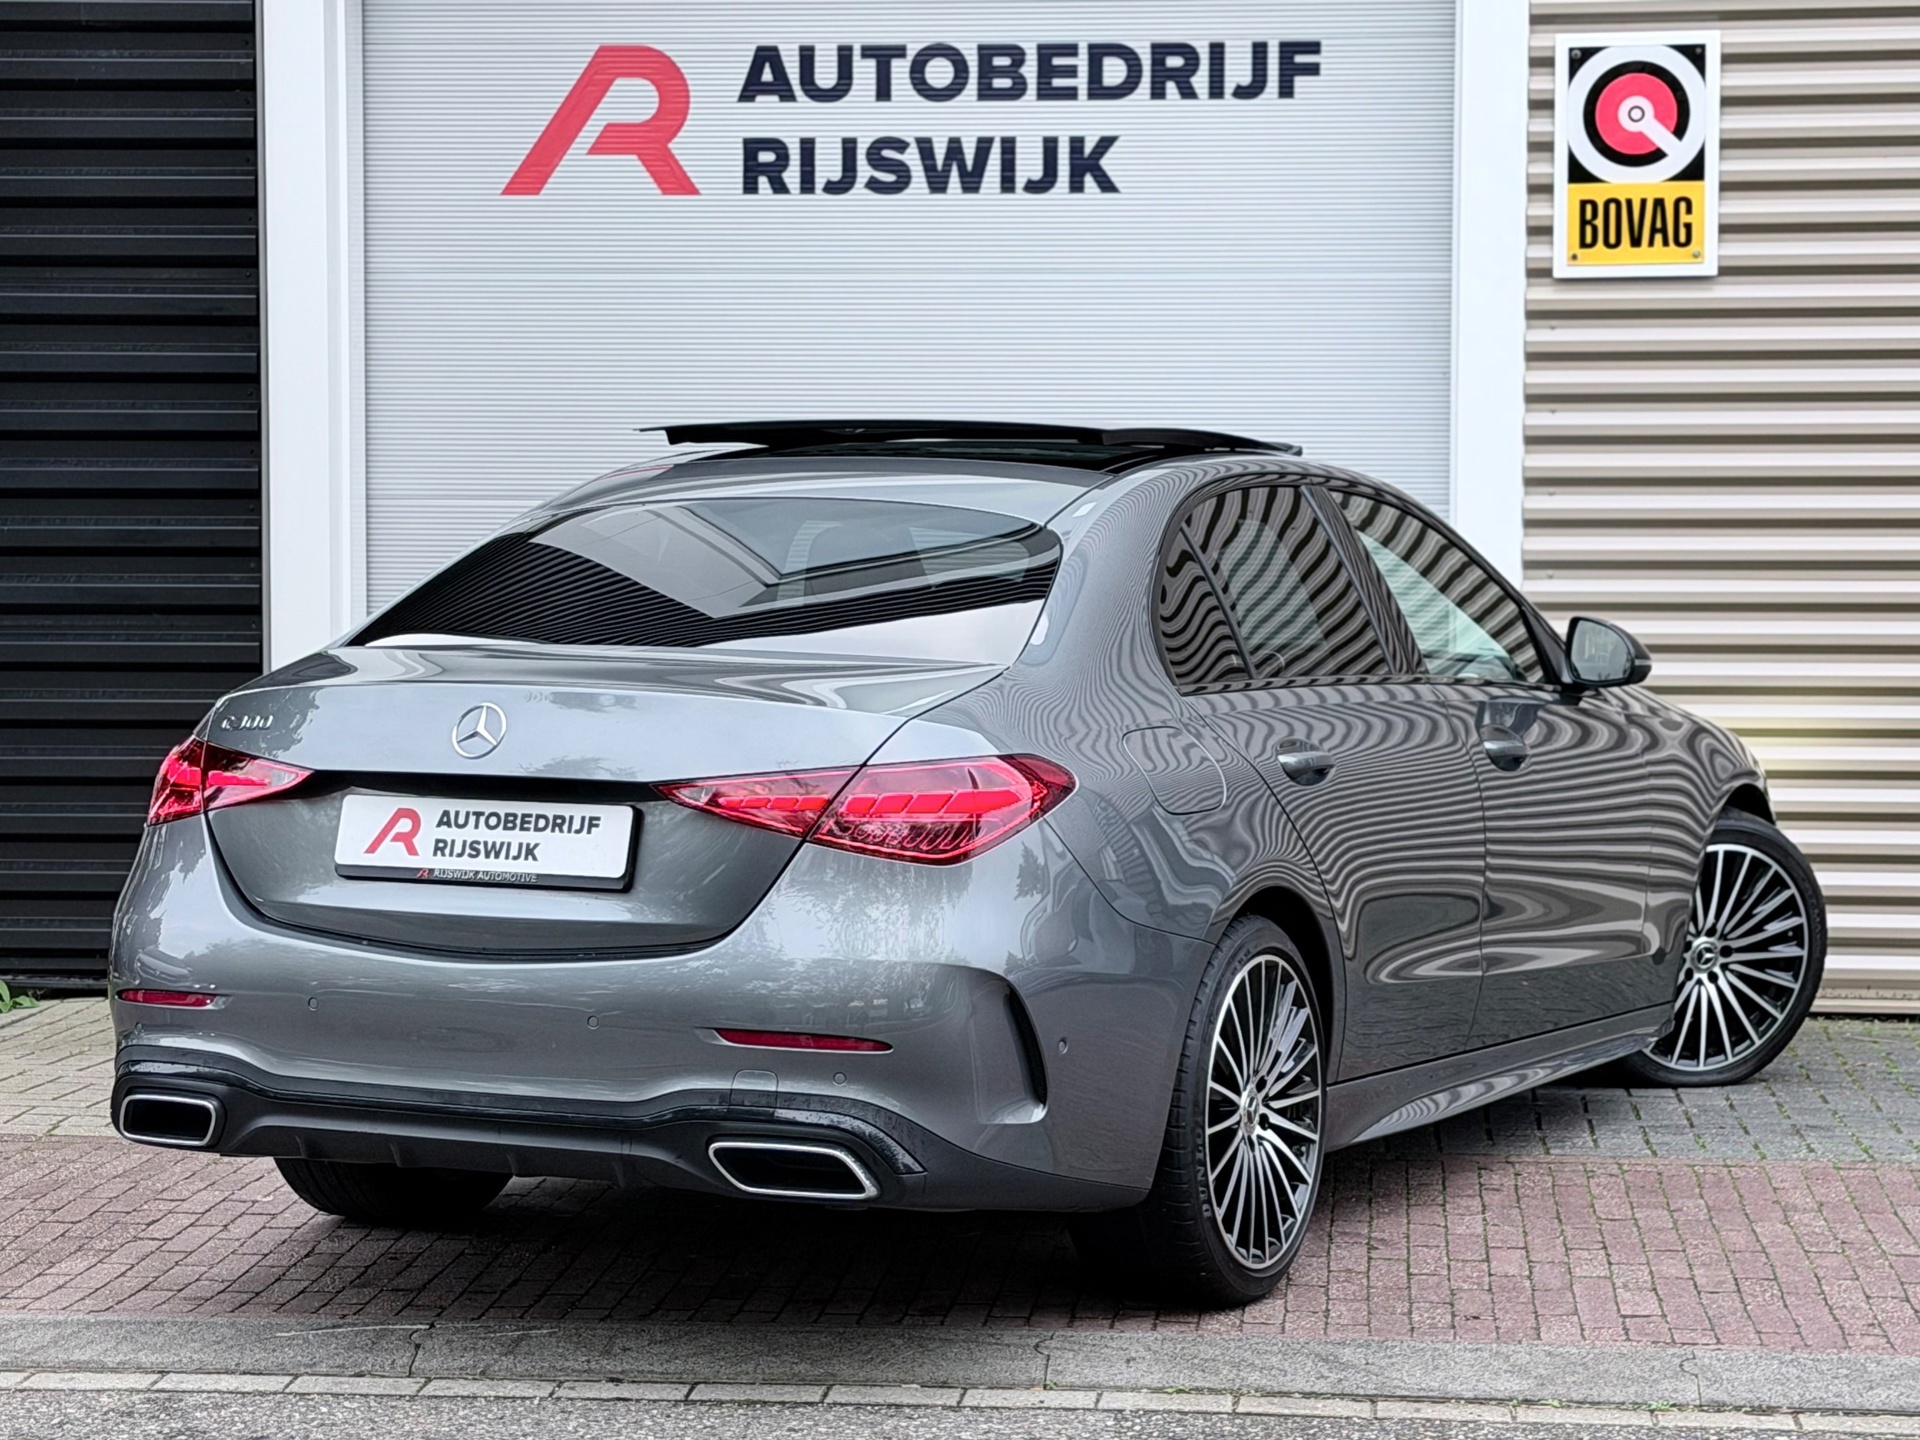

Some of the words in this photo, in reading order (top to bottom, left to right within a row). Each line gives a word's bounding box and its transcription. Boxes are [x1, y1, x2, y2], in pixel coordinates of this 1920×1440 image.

[737, 40, 1323, 103] AUTOBEDRIJF
[742, 135, 1121, 196] RIJSWIJK
[1578, 195, 1694, 250] BOVAG
[435, 809, 602, 836] AUTOBEDRIJF
[432, 838, 541, 862] RIJSWIJK
[477, 872, 539, 883] AUTOMOTIVE
